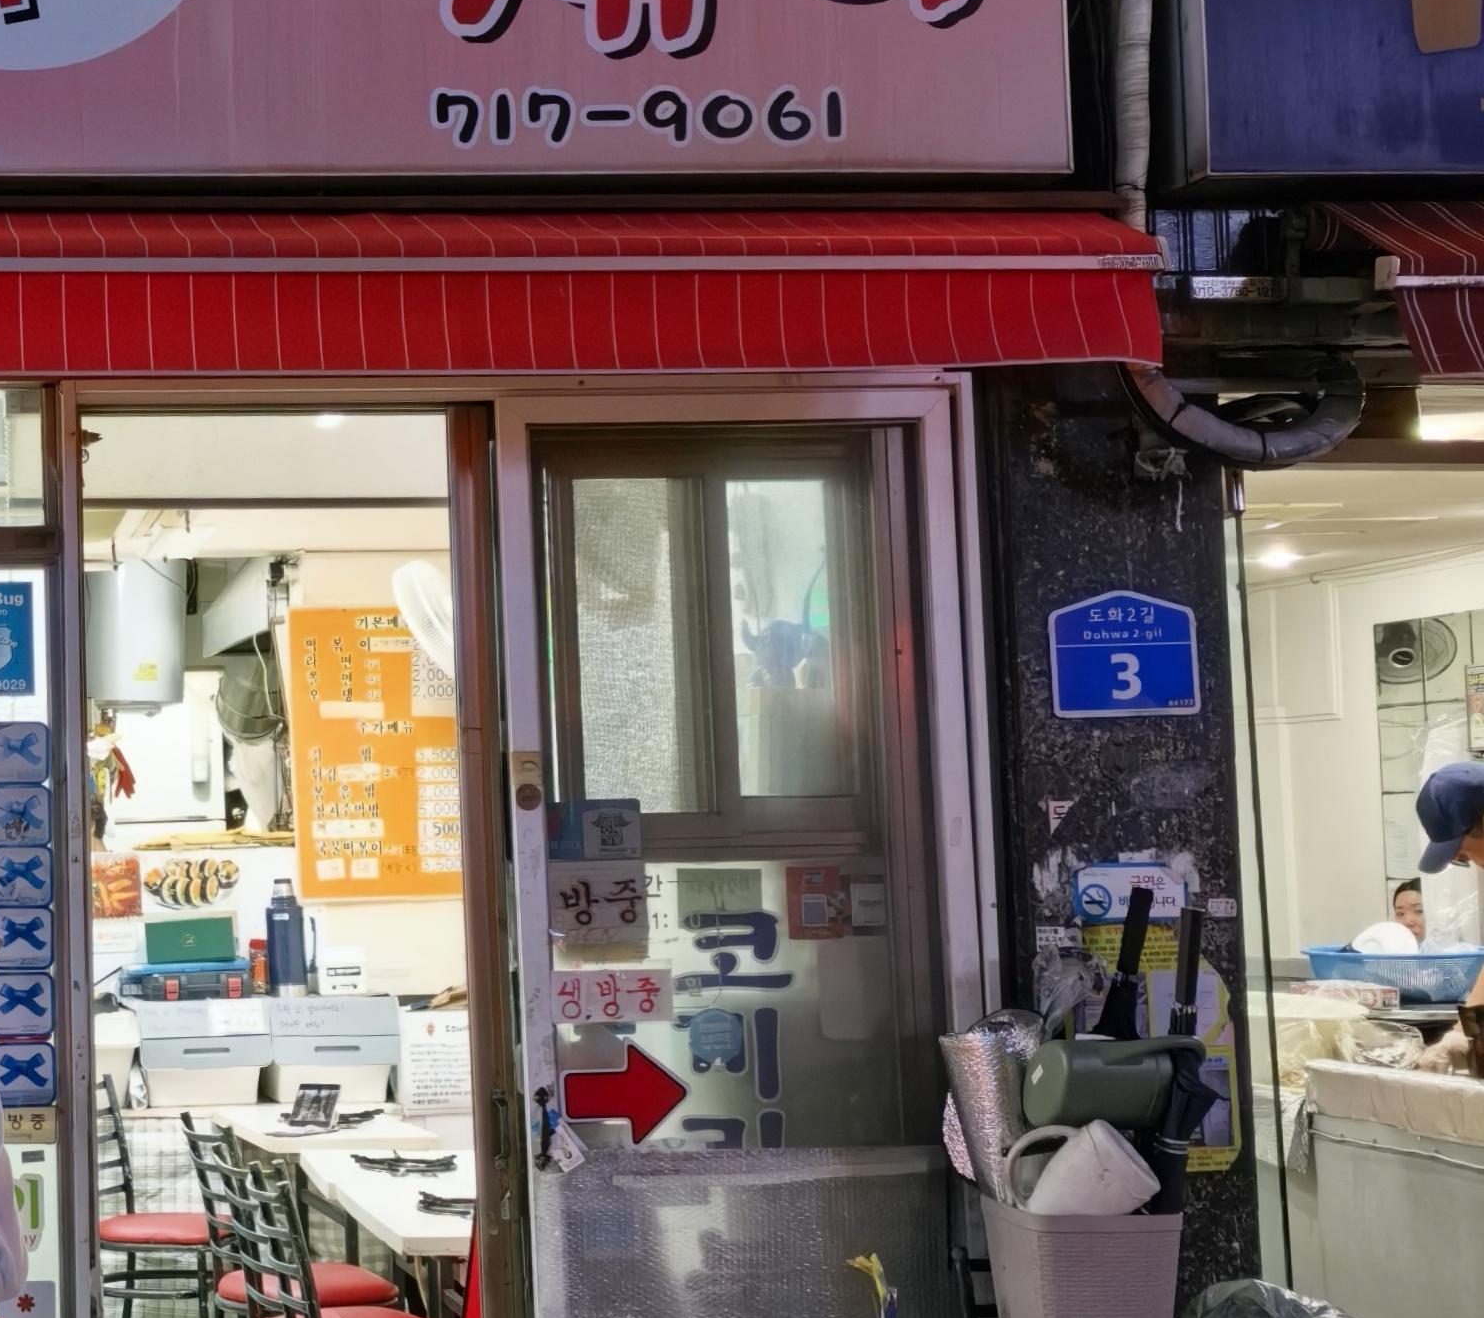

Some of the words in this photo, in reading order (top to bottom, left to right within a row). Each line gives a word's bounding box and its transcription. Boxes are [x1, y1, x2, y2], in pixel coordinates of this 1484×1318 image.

[432, 87, 847, 148] 717-9061
[357, 615, 408, 630] 기본메
[1088, 606, 1154, 624] 도화2길
[1083, 630, 1129, 640] Dohwa
[1133, 629, 1162, 640] 2-gil
[1110, 652, 1142, 700] 3
